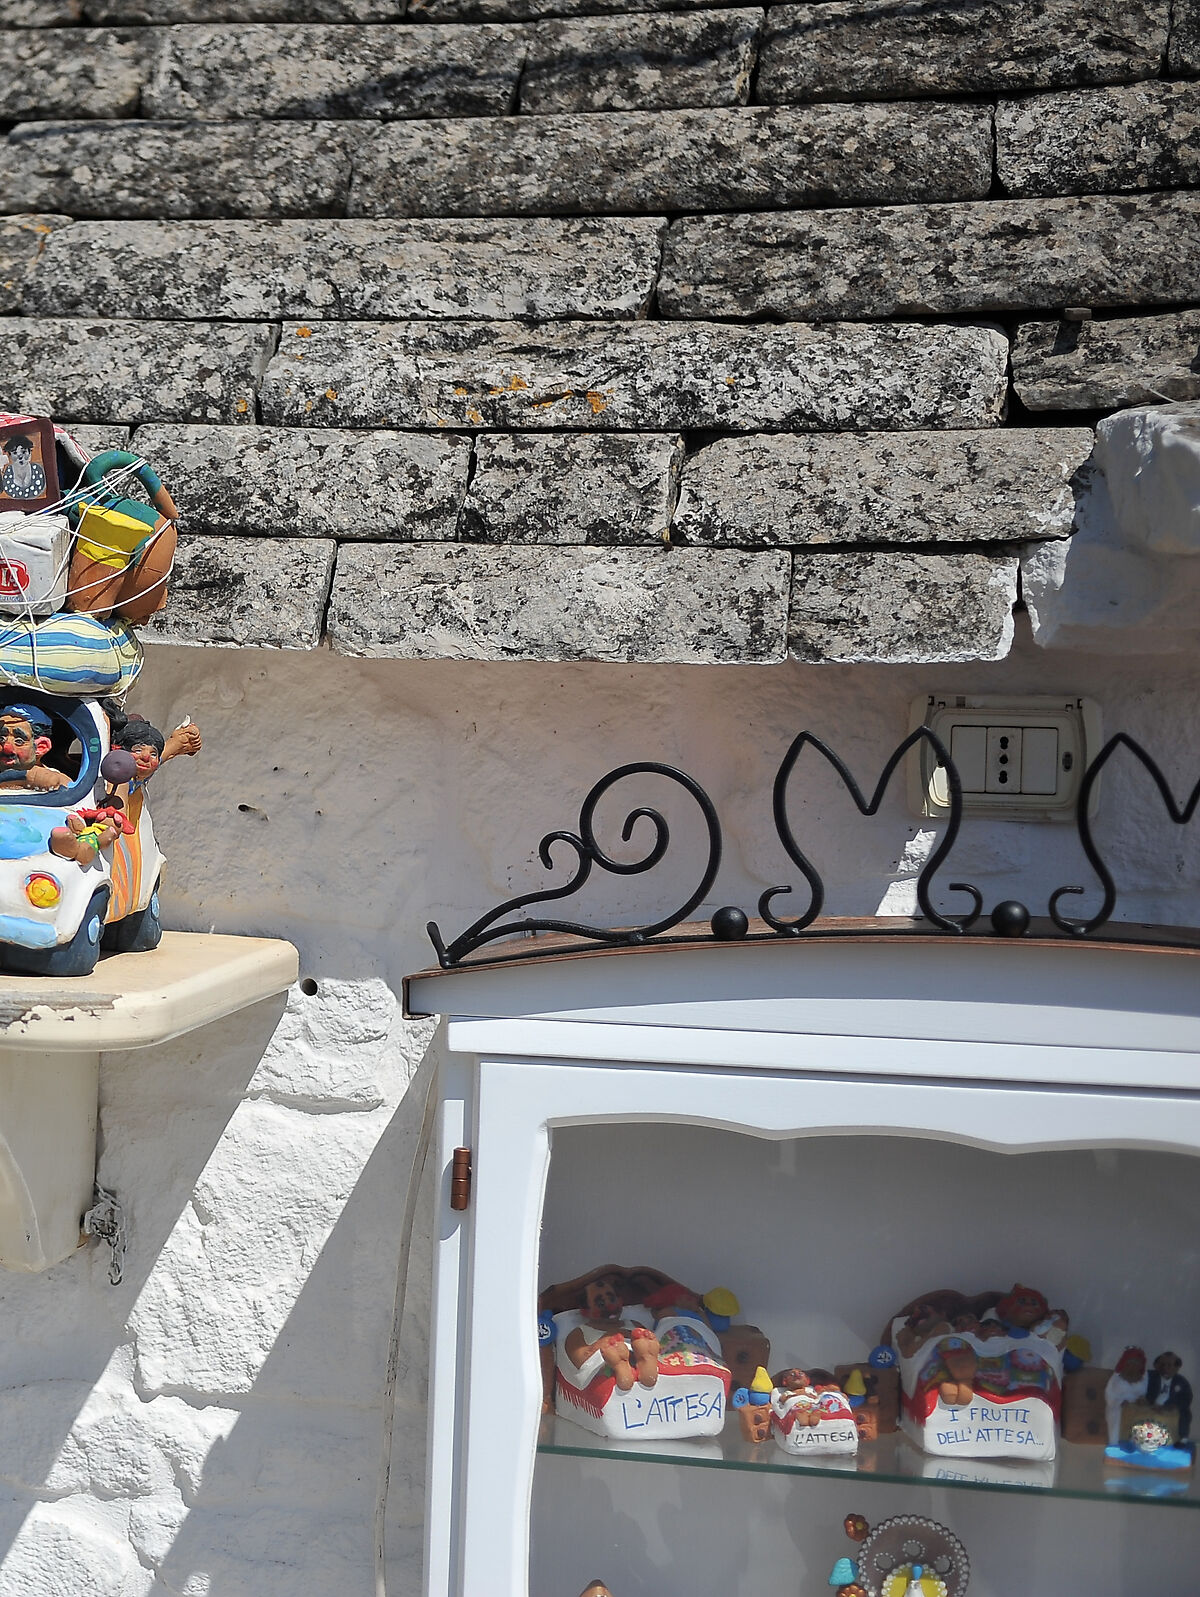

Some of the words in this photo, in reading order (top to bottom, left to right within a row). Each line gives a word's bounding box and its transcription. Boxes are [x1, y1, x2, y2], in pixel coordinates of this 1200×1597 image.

[621, 1392, 722, 1429] L'ATTESA
[948, 1409, 958, 1422] I
[970, 1407, 1030, 1423] FRUTTI
[794, 1431, 855, 1445] L'ATTESA
